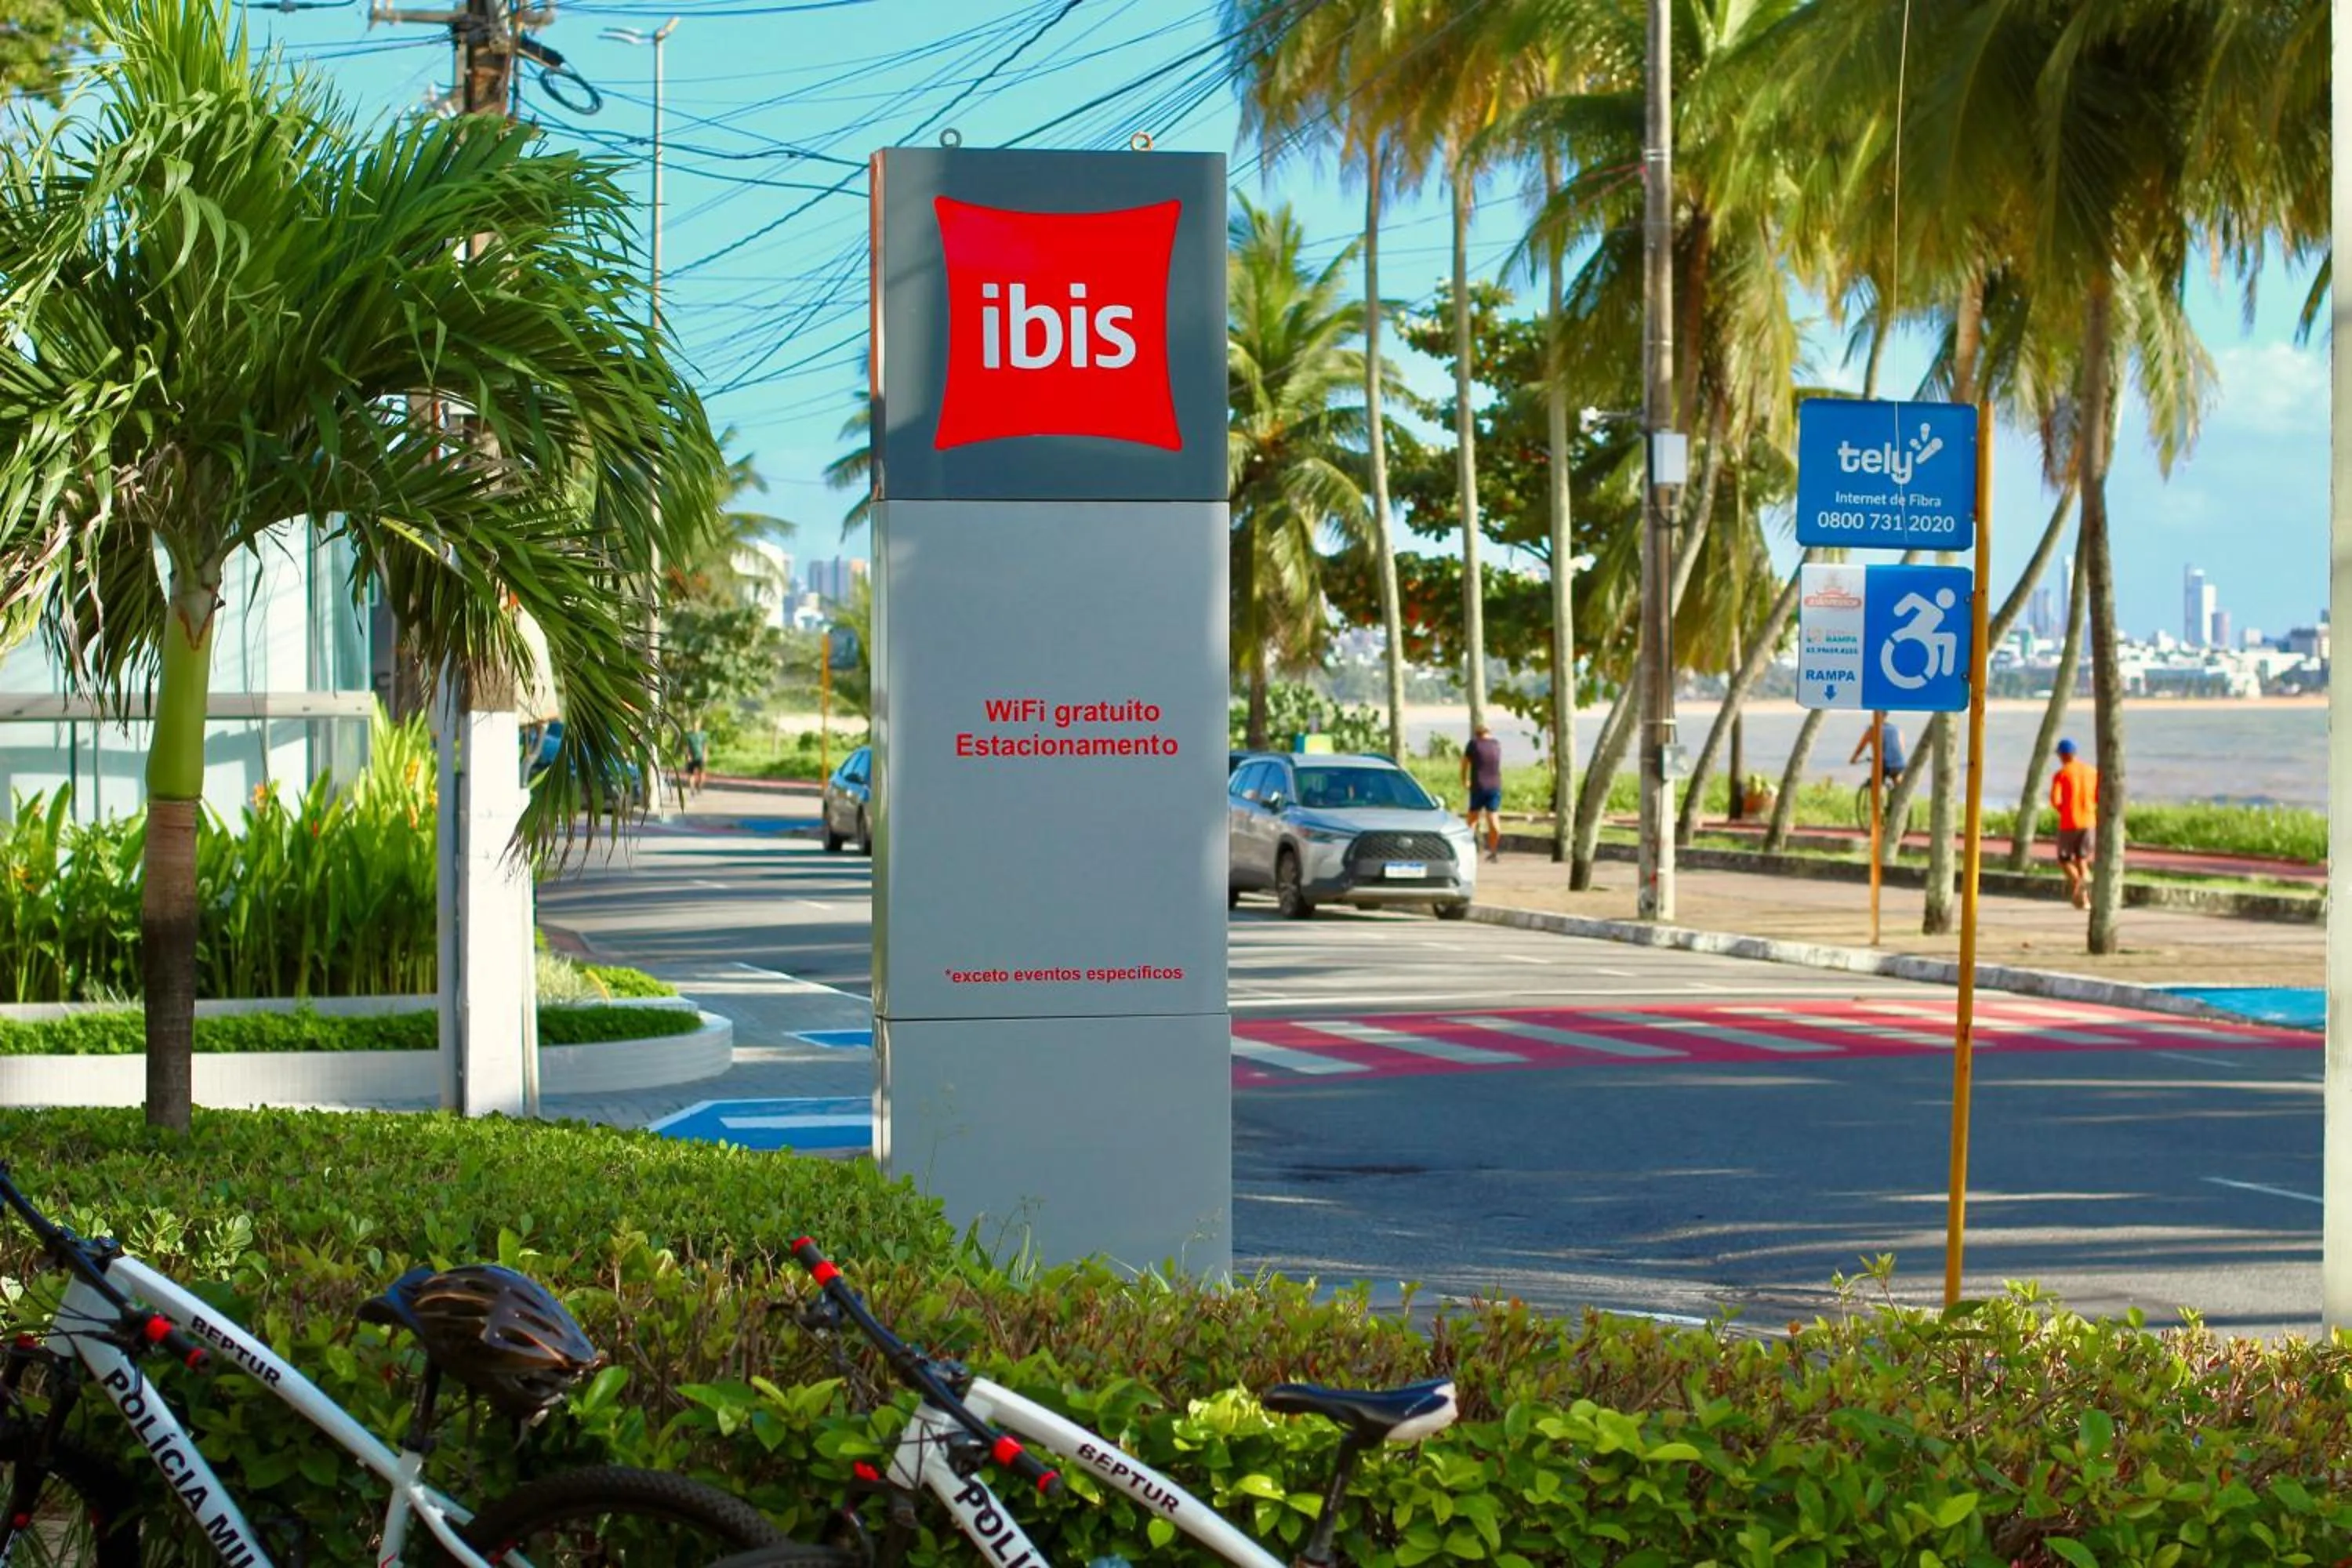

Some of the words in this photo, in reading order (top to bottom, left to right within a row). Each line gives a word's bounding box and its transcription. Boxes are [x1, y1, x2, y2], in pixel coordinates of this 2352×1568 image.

[982, 283, 1136, 368] ibis
[1838, 441, 1913, 485] tely
[1835, 492, 1886, 505] Internet
[1889, 494, 1905, 506] de
[1909, 494, 1941, 507] Fibra
[1817, 512, 1864, 529] 0800
[1869, 514, 1903, 531] 731
[1908, 516, 1955, 532] 2020
[1806, 669, 1856, 681] RAMPA
[985, 700, 1045, 721] WiFi
[1054, 699, 1160, 728] gratuito
[956, 734, 1178, 756] Estacionamento
[1014, 967, 1081, 981] eventos
[191, 1315, 281, 1388] BEPTUR
[103, 1368, 209, 1514] POLÍCIA
[1077, 1443, 1179, 1513] BEPTUR
